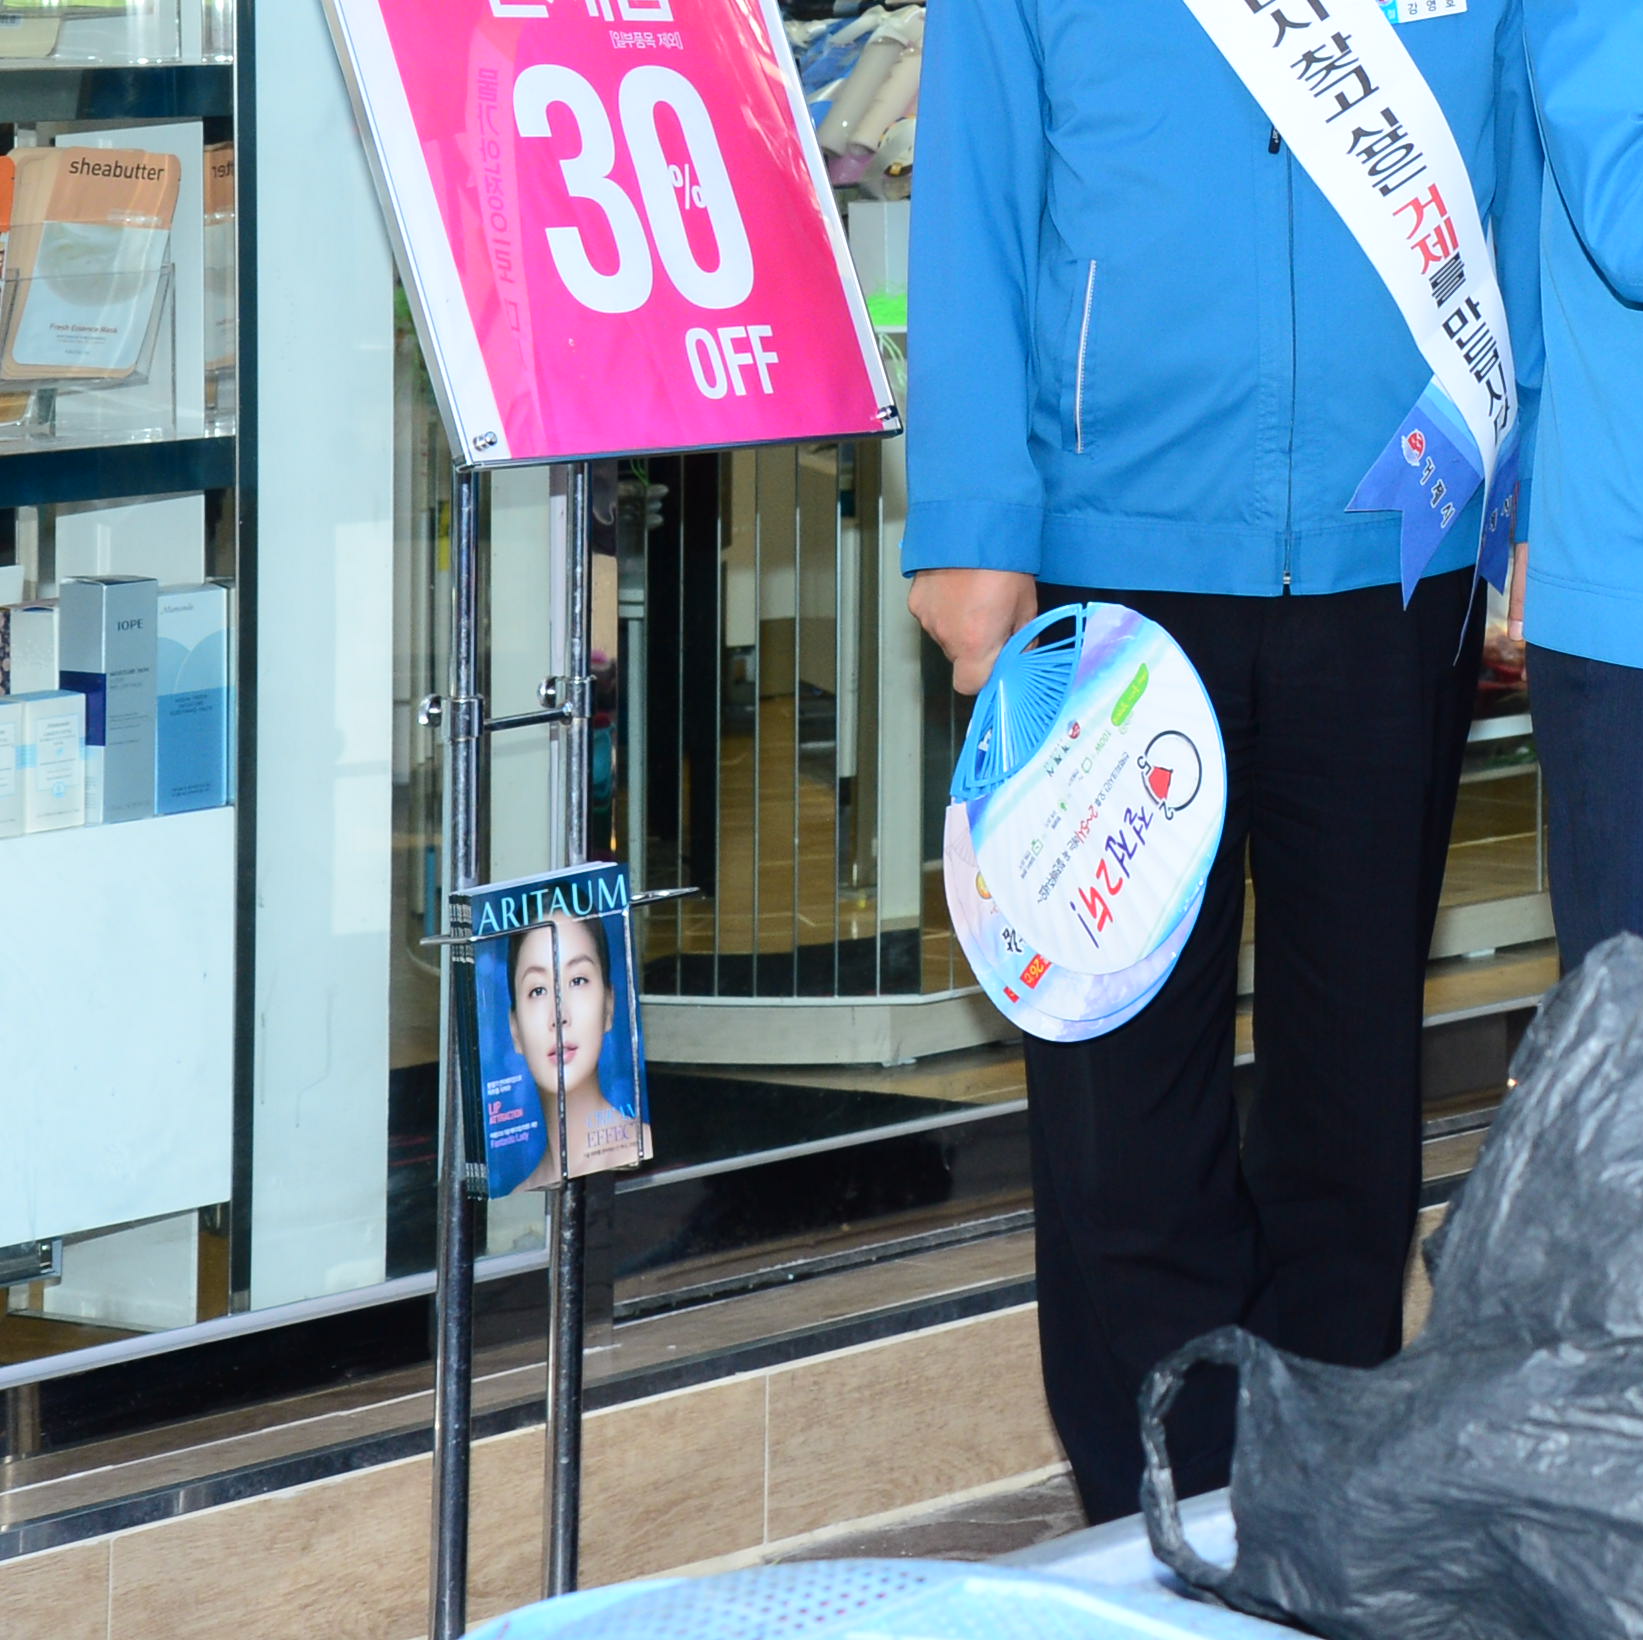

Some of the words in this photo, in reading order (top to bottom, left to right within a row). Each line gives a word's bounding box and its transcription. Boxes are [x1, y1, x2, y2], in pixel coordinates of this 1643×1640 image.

[69, 158, 164, 181] sheabutter
[1291, 35, 1379, 124] 찾고
[1346, 108, 1428, 198] 싶은
[1393, 182, 1467, 305] 거제를
[1441, 300, 1512, 447] 만듭시다
[686, 325, 778, 399] OFF
[1420, 456, 1456, 529] 거제시
[117, 619, 144, 632] IOPE
[1136, 754, 1152, 775] 5
[1159, 801, 1175, 822] 2
[478, 874, 628, 935] ARITAUM
[587, 1122, 636, 1148] EFFEC
